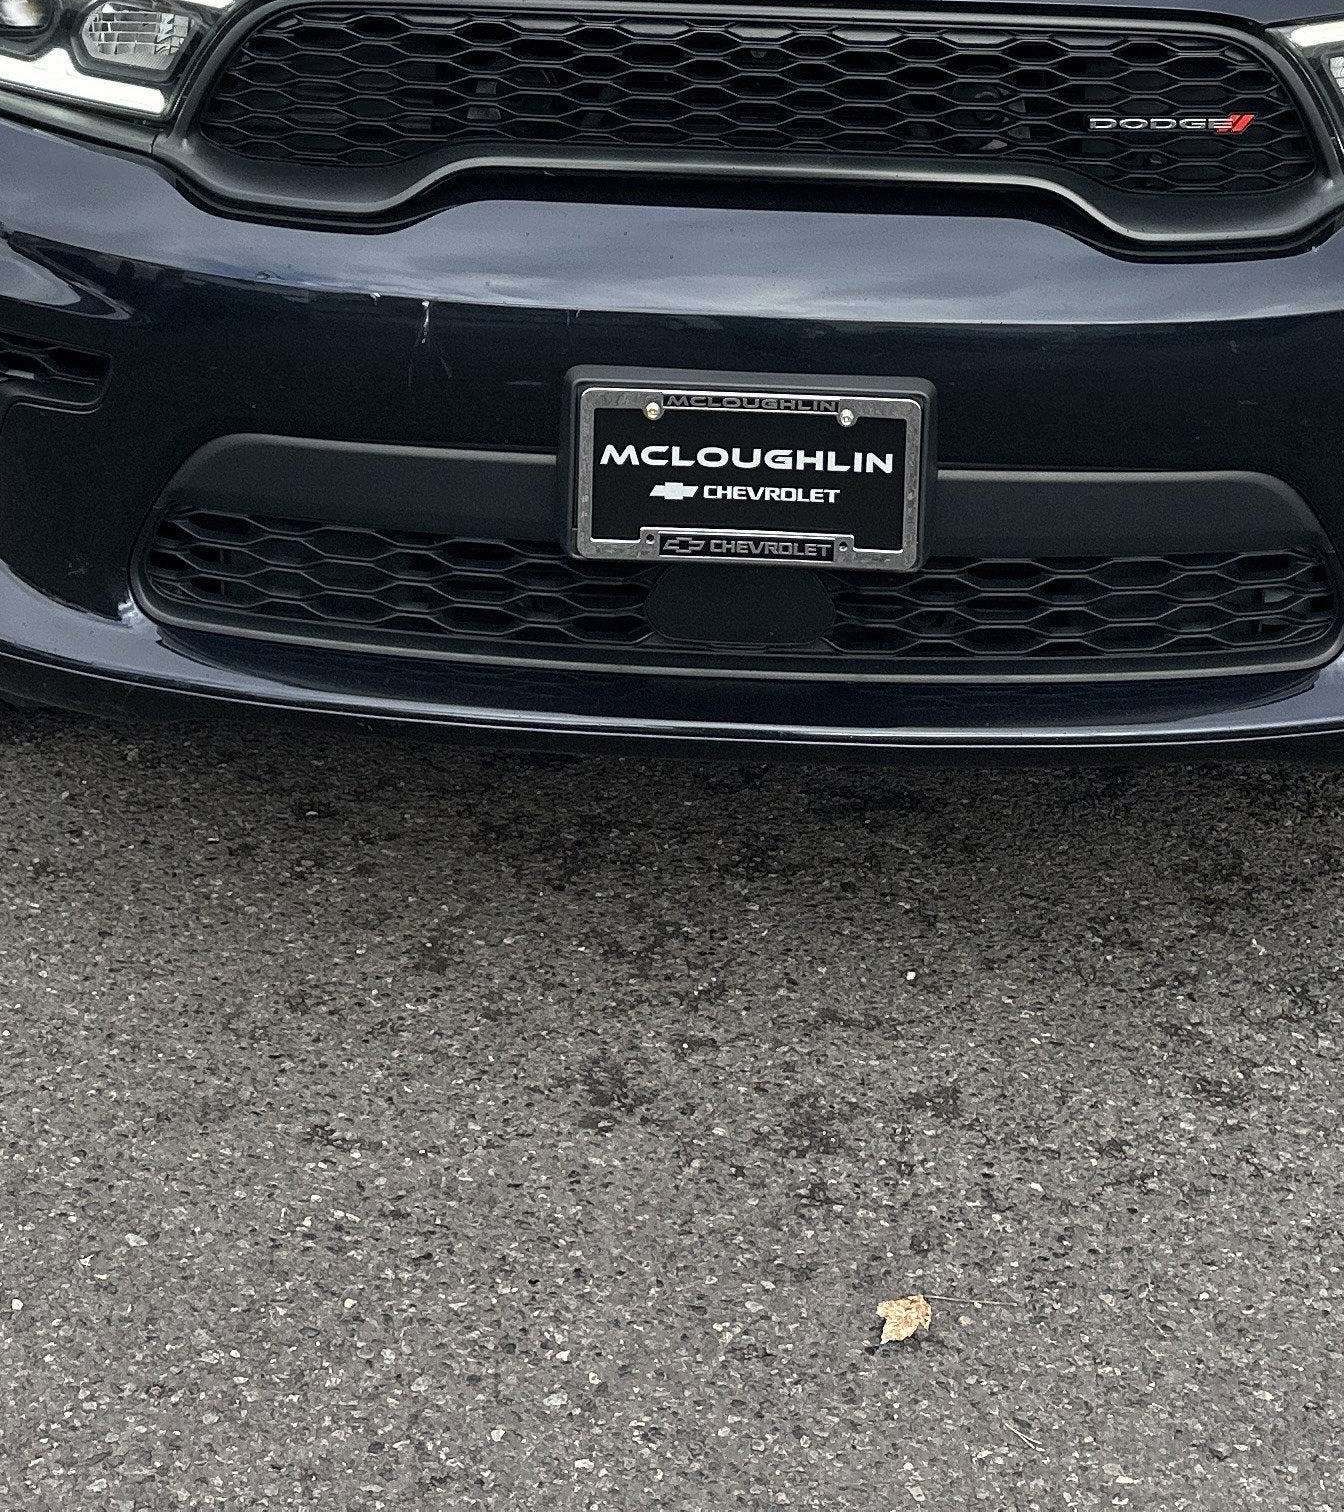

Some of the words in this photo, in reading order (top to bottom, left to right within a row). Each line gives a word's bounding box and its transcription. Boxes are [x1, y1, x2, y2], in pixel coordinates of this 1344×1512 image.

[1089, 117, 1234, 130] DODGE
[666, 394, 836, 413] MCLOUGHLIN
[599, 443, 895, 475] MCLOUGHLIN
[702, 485, 841, 504] CHEVROLET
[709, 539, 833, 557] CHEVROLET
